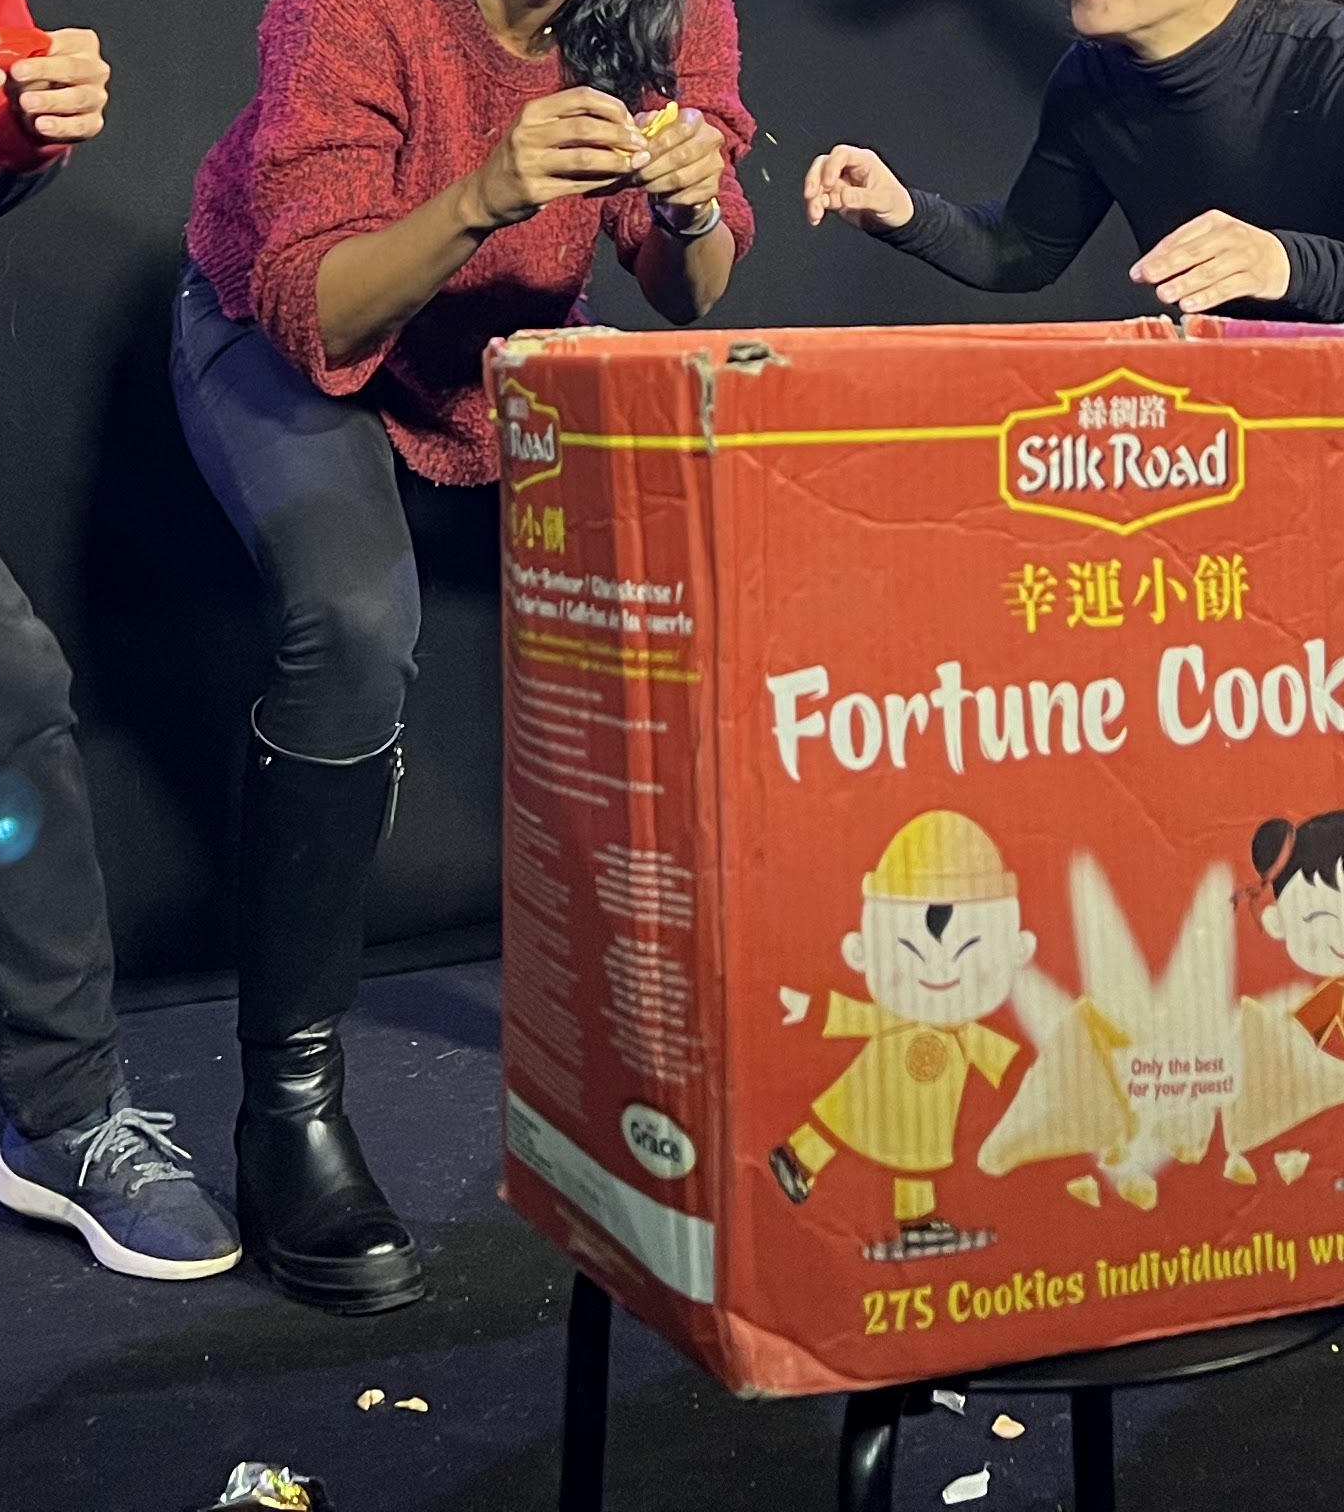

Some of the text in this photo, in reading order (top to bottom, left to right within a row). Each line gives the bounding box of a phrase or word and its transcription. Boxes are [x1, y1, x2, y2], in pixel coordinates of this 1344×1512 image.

[1016, 427, 1230, 493] Silk Road
[1001, 552, 1252, 634] 幸運小餅
[766, 659, 1127, 785] Fortune
[1127, 1079, 1149, 1097] for
[1154, 1080, 1187, 1101] your
[1131, 1056, 1224, 1079] Only the best
[862, 1284, 934, 1336] 275
[946, 1268, 1086, 1322] Cookies
[1096, 1240, 1297, 1302] individually
